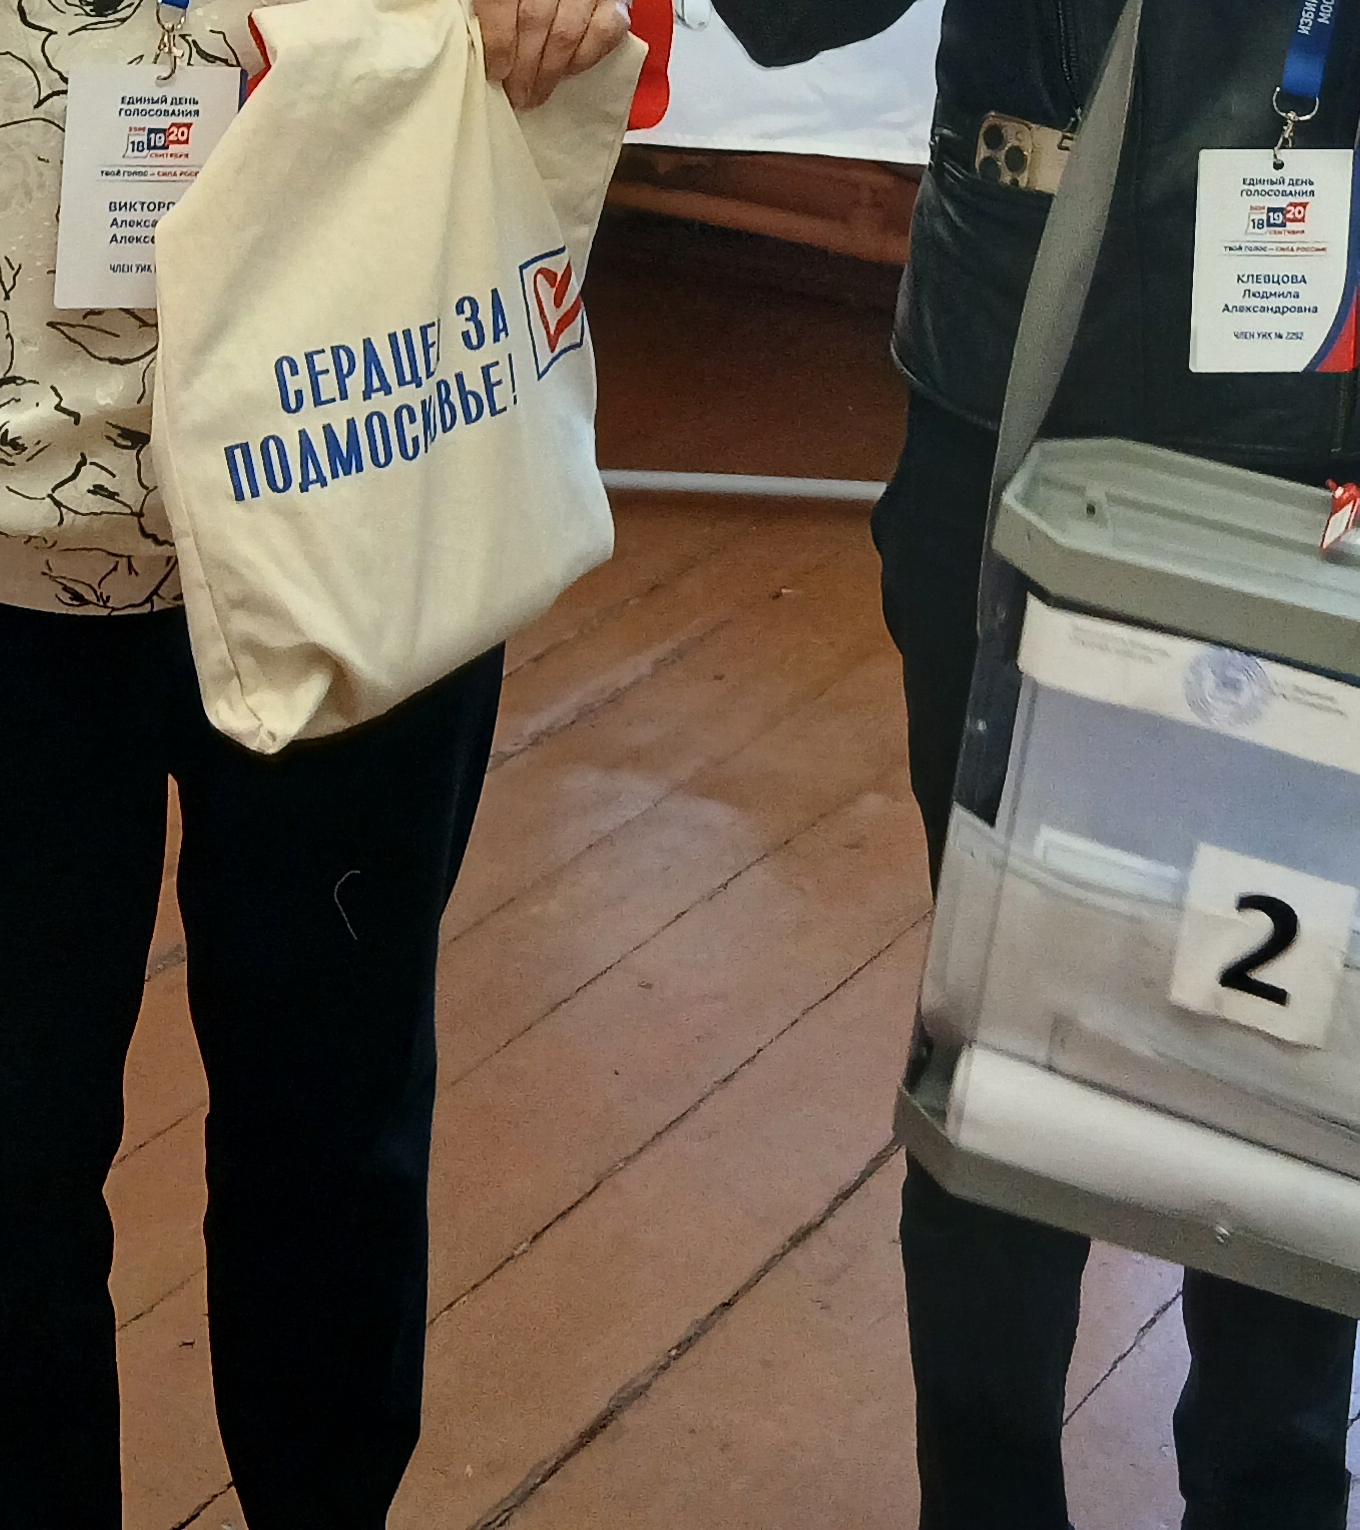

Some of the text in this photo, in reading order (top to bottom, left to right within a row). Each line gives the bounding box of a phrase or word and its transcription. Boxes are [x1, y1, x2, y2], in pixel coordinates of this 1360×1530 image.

[120, 95, 199, 107] ЕДИНЫЙ ДЕНЬ
[118, 108, 200, 118] ГОЛОСОВАНИЯ
[168, 126, 188, 141] 20
[1242, 176, 1315, 187] ЕДИНЫЙ ДЕНЬ
[1240, 188, 1315, 198] ГОЛОСОВАНИЯ
[1251, 206, 1304, 230] 18 19 20
[109, 263, 133, 274] ЧЛЕН
[135, 263, 153, 274] УИК
[1237, 274, 1307, 287] КЛЕВЦОВА
[1242, 289, 1300, 300] Людмила
[1222, 304, 1318, 316] Александровна
[1233, 331, 1255, 341] ЧЛЕН
[1256, 331, 1272, 341] УИК
[274, 288, 510, 414] СЕРДЦЕ ЗА
[1217, 893, 1299, 1007] 2
